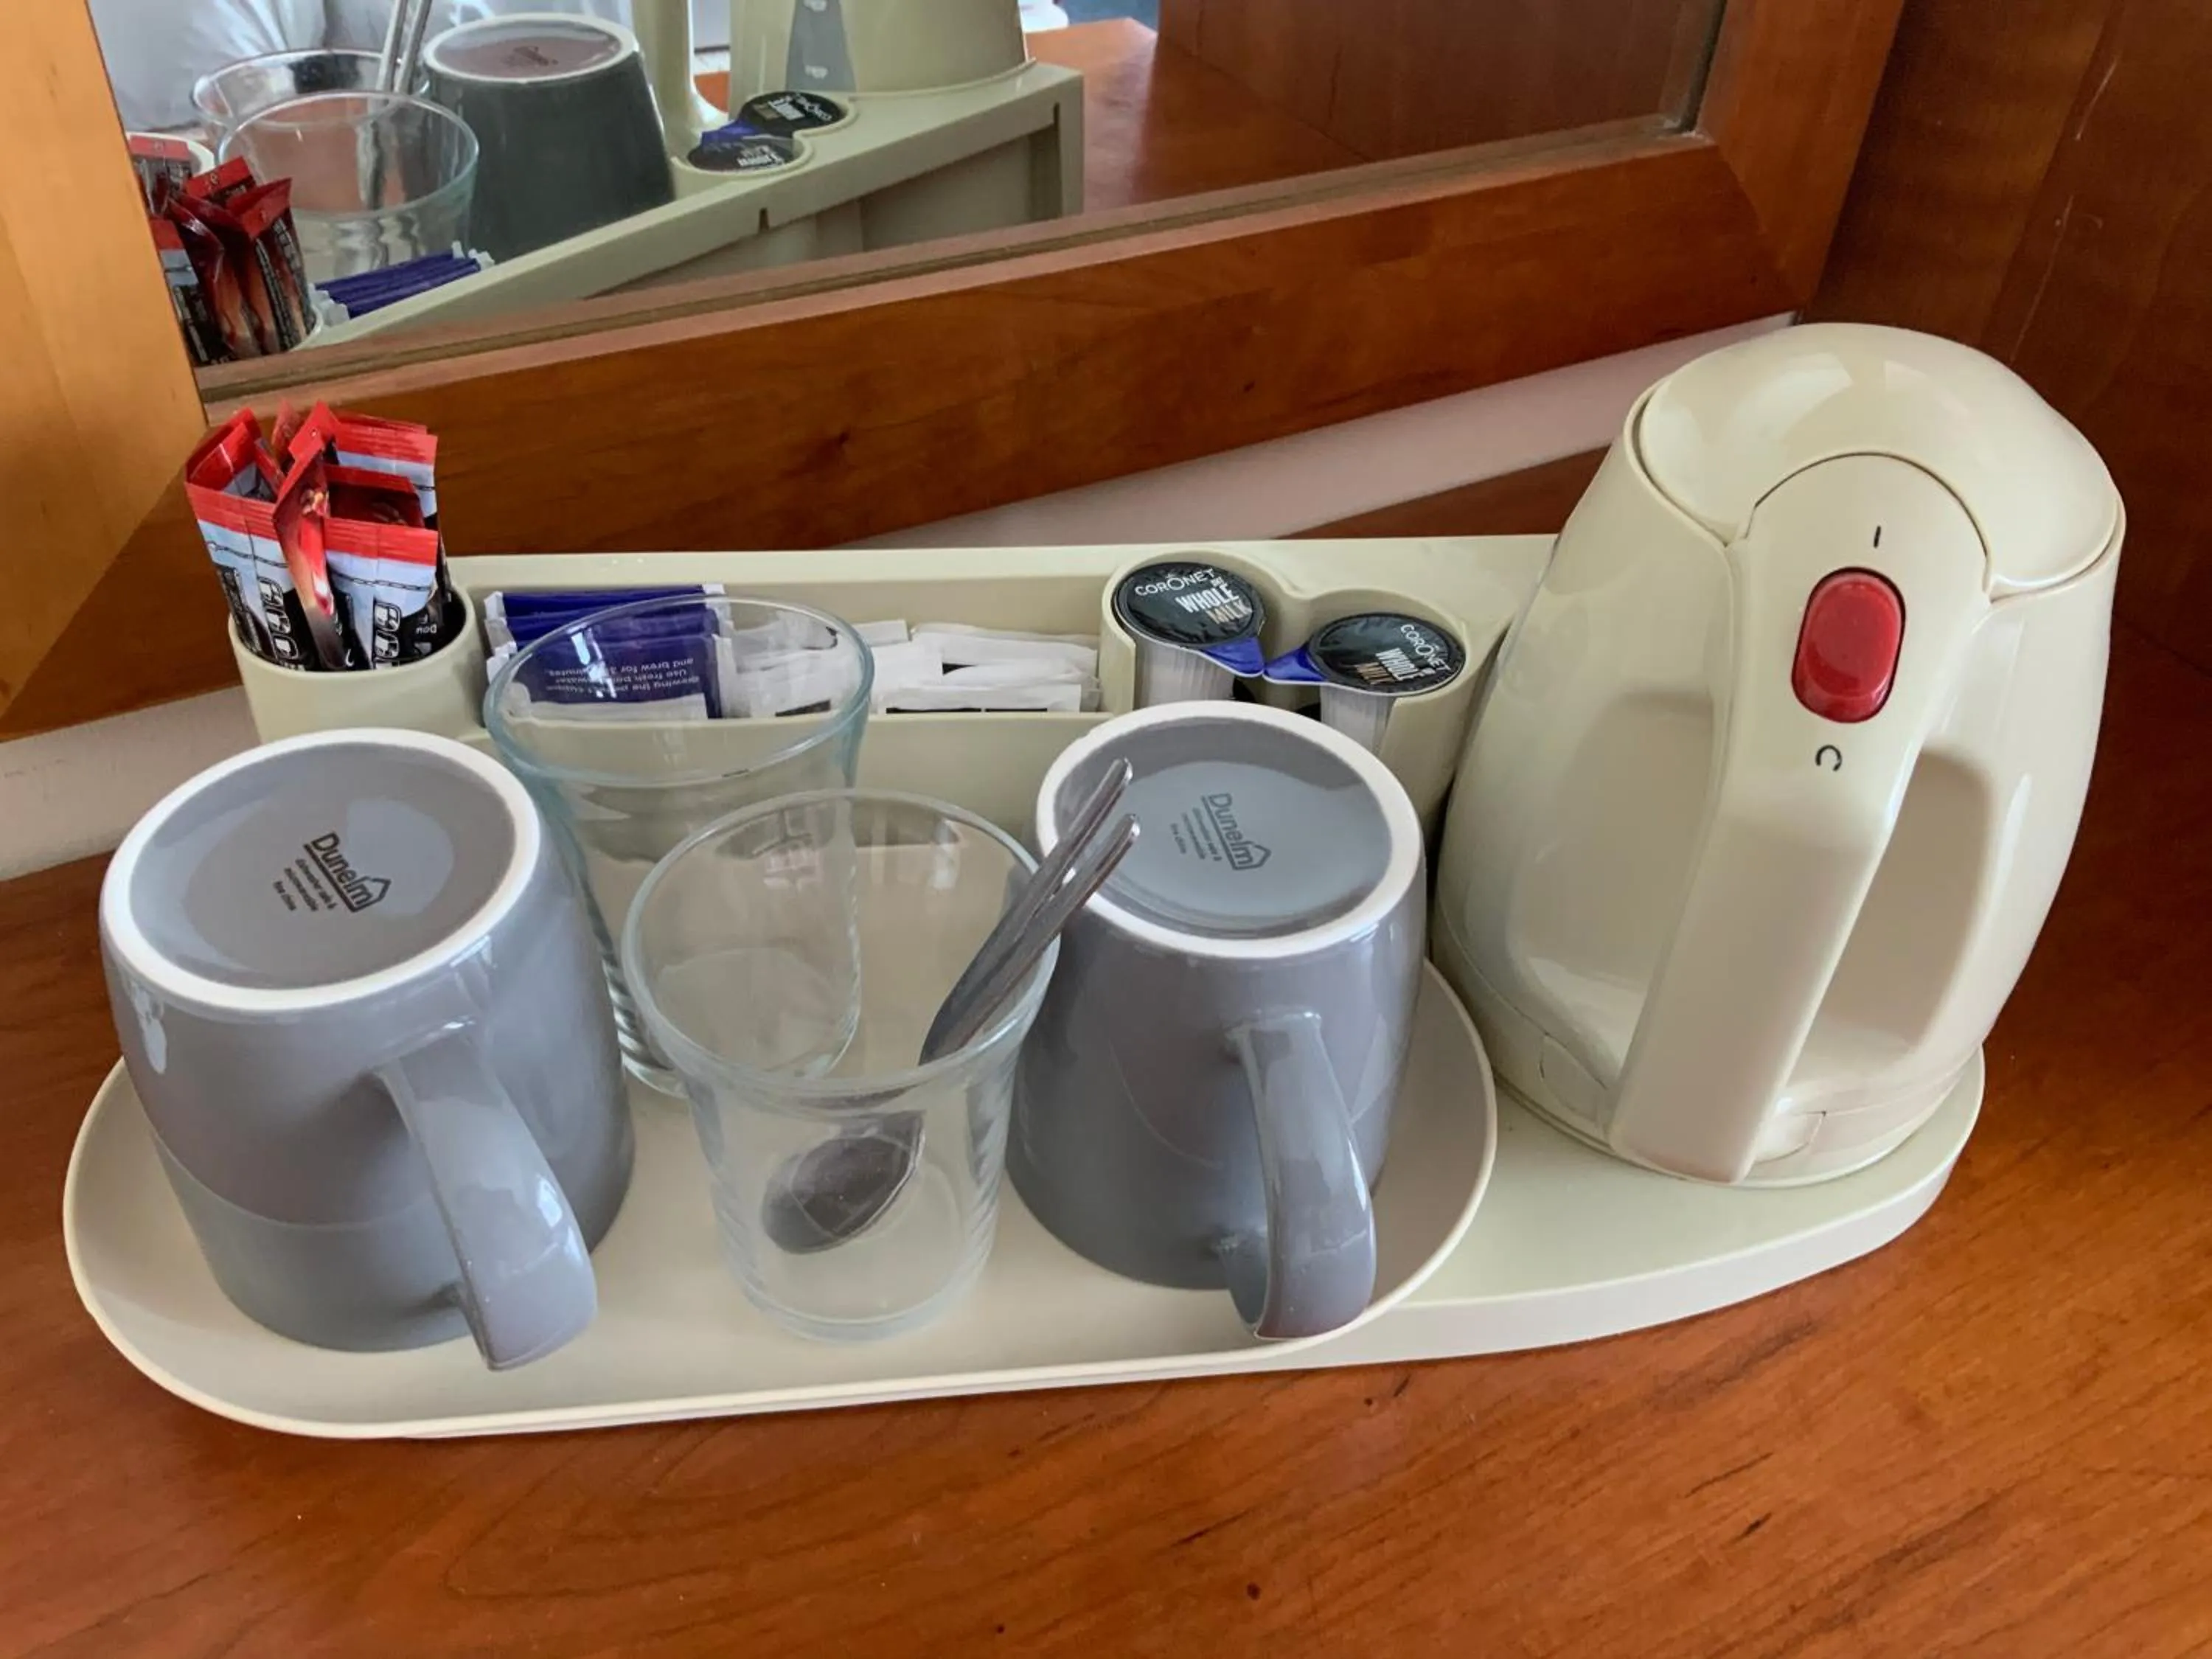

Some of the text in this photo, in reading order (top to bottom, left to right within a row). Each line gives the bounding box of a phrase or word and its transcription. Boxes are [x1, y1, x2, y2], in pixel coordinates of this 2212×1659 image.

[1134, 568, 1215, 597] CORONET
[1175, 582, 1239, 613] WHOLE
[1205, 599, 1253, 625] MILK
[620, 665, 638, 674] for
[641, 661, 670, 671] brew
[672, 657, 694, 667] and
[666, 669, 687, 678] Use
[632, 680, 651, 691] the
[1206, 792, 1256, 867] Dunelm
[310, 832, 376, 907] Dunelm
